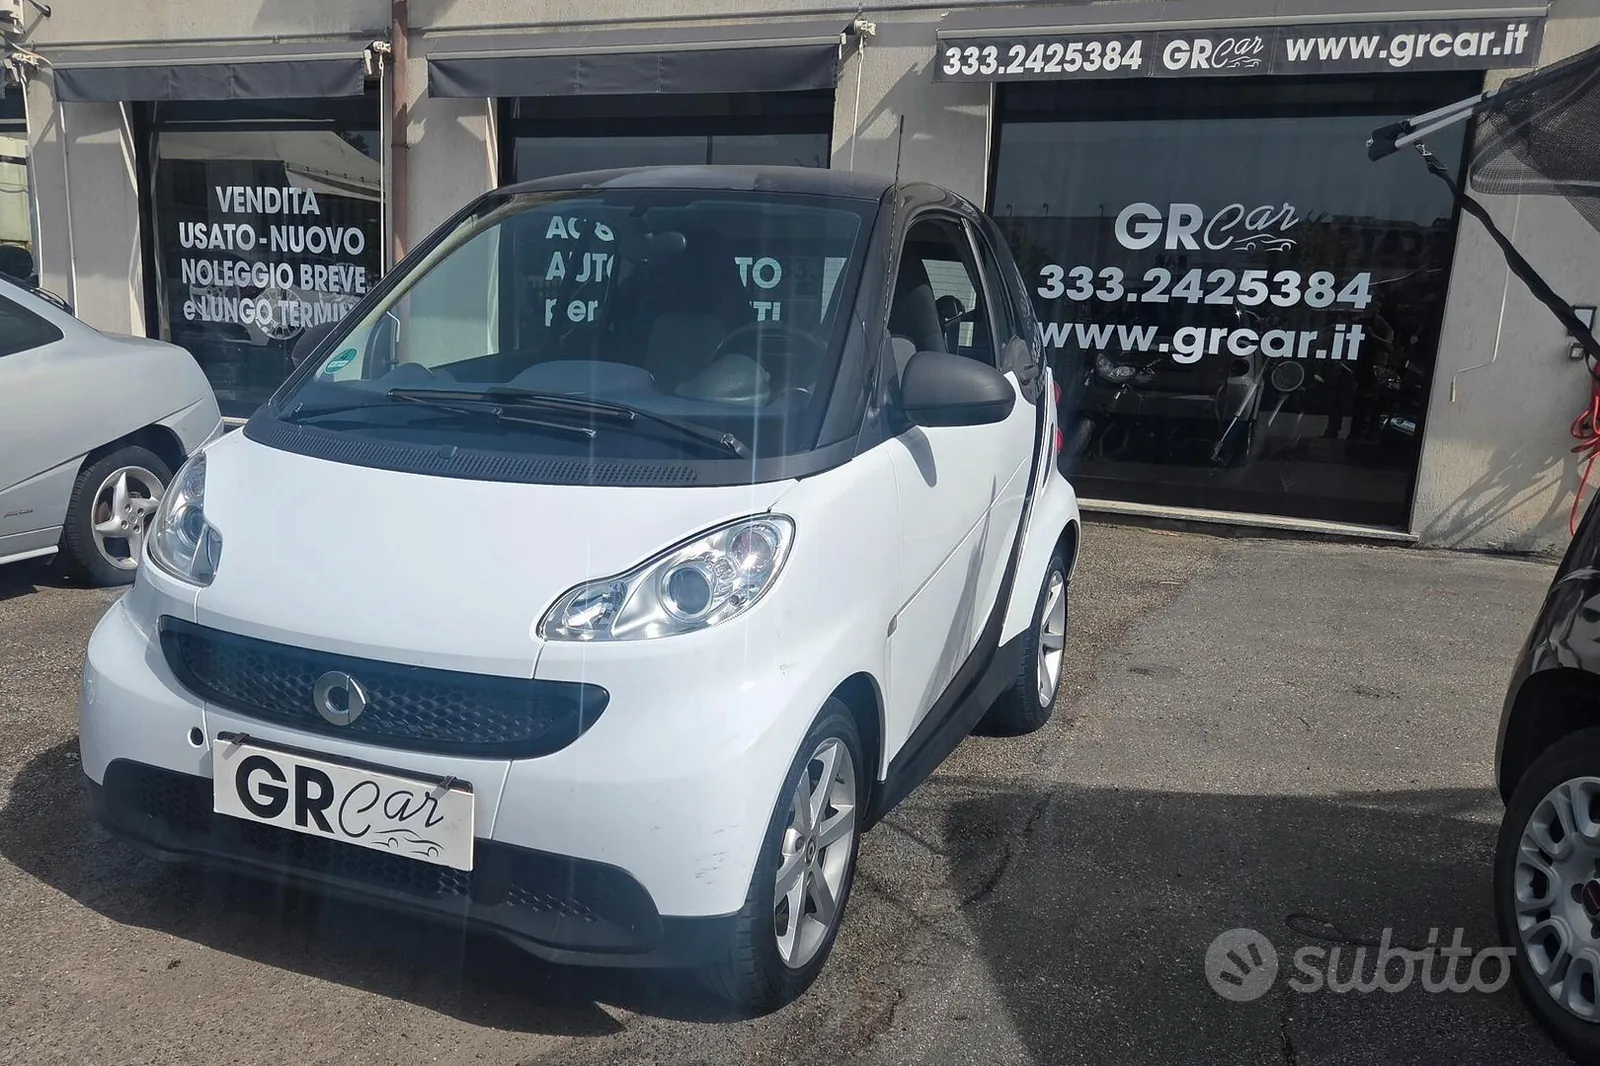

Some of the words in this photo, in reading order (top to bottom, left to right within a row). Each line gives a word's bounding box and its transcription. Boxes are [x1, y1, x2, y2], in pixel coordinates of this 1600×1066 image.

[943, 40, 1143, 75] 333.2425384
[1286, 23, 1529, 67] www.grcar.it
[215, 186, 320, 215] VENDITA
[181, 258, 294, 290] NOLEGGIO
[300, 264, 366, 293] BREVE
[1037, 264, 1372, 309] 333.2425384
[183, 300, 196, 320] e
[201, 298, 272, 325] LUNGO
[1038, 322, 1365, 364] www.grcar.it
